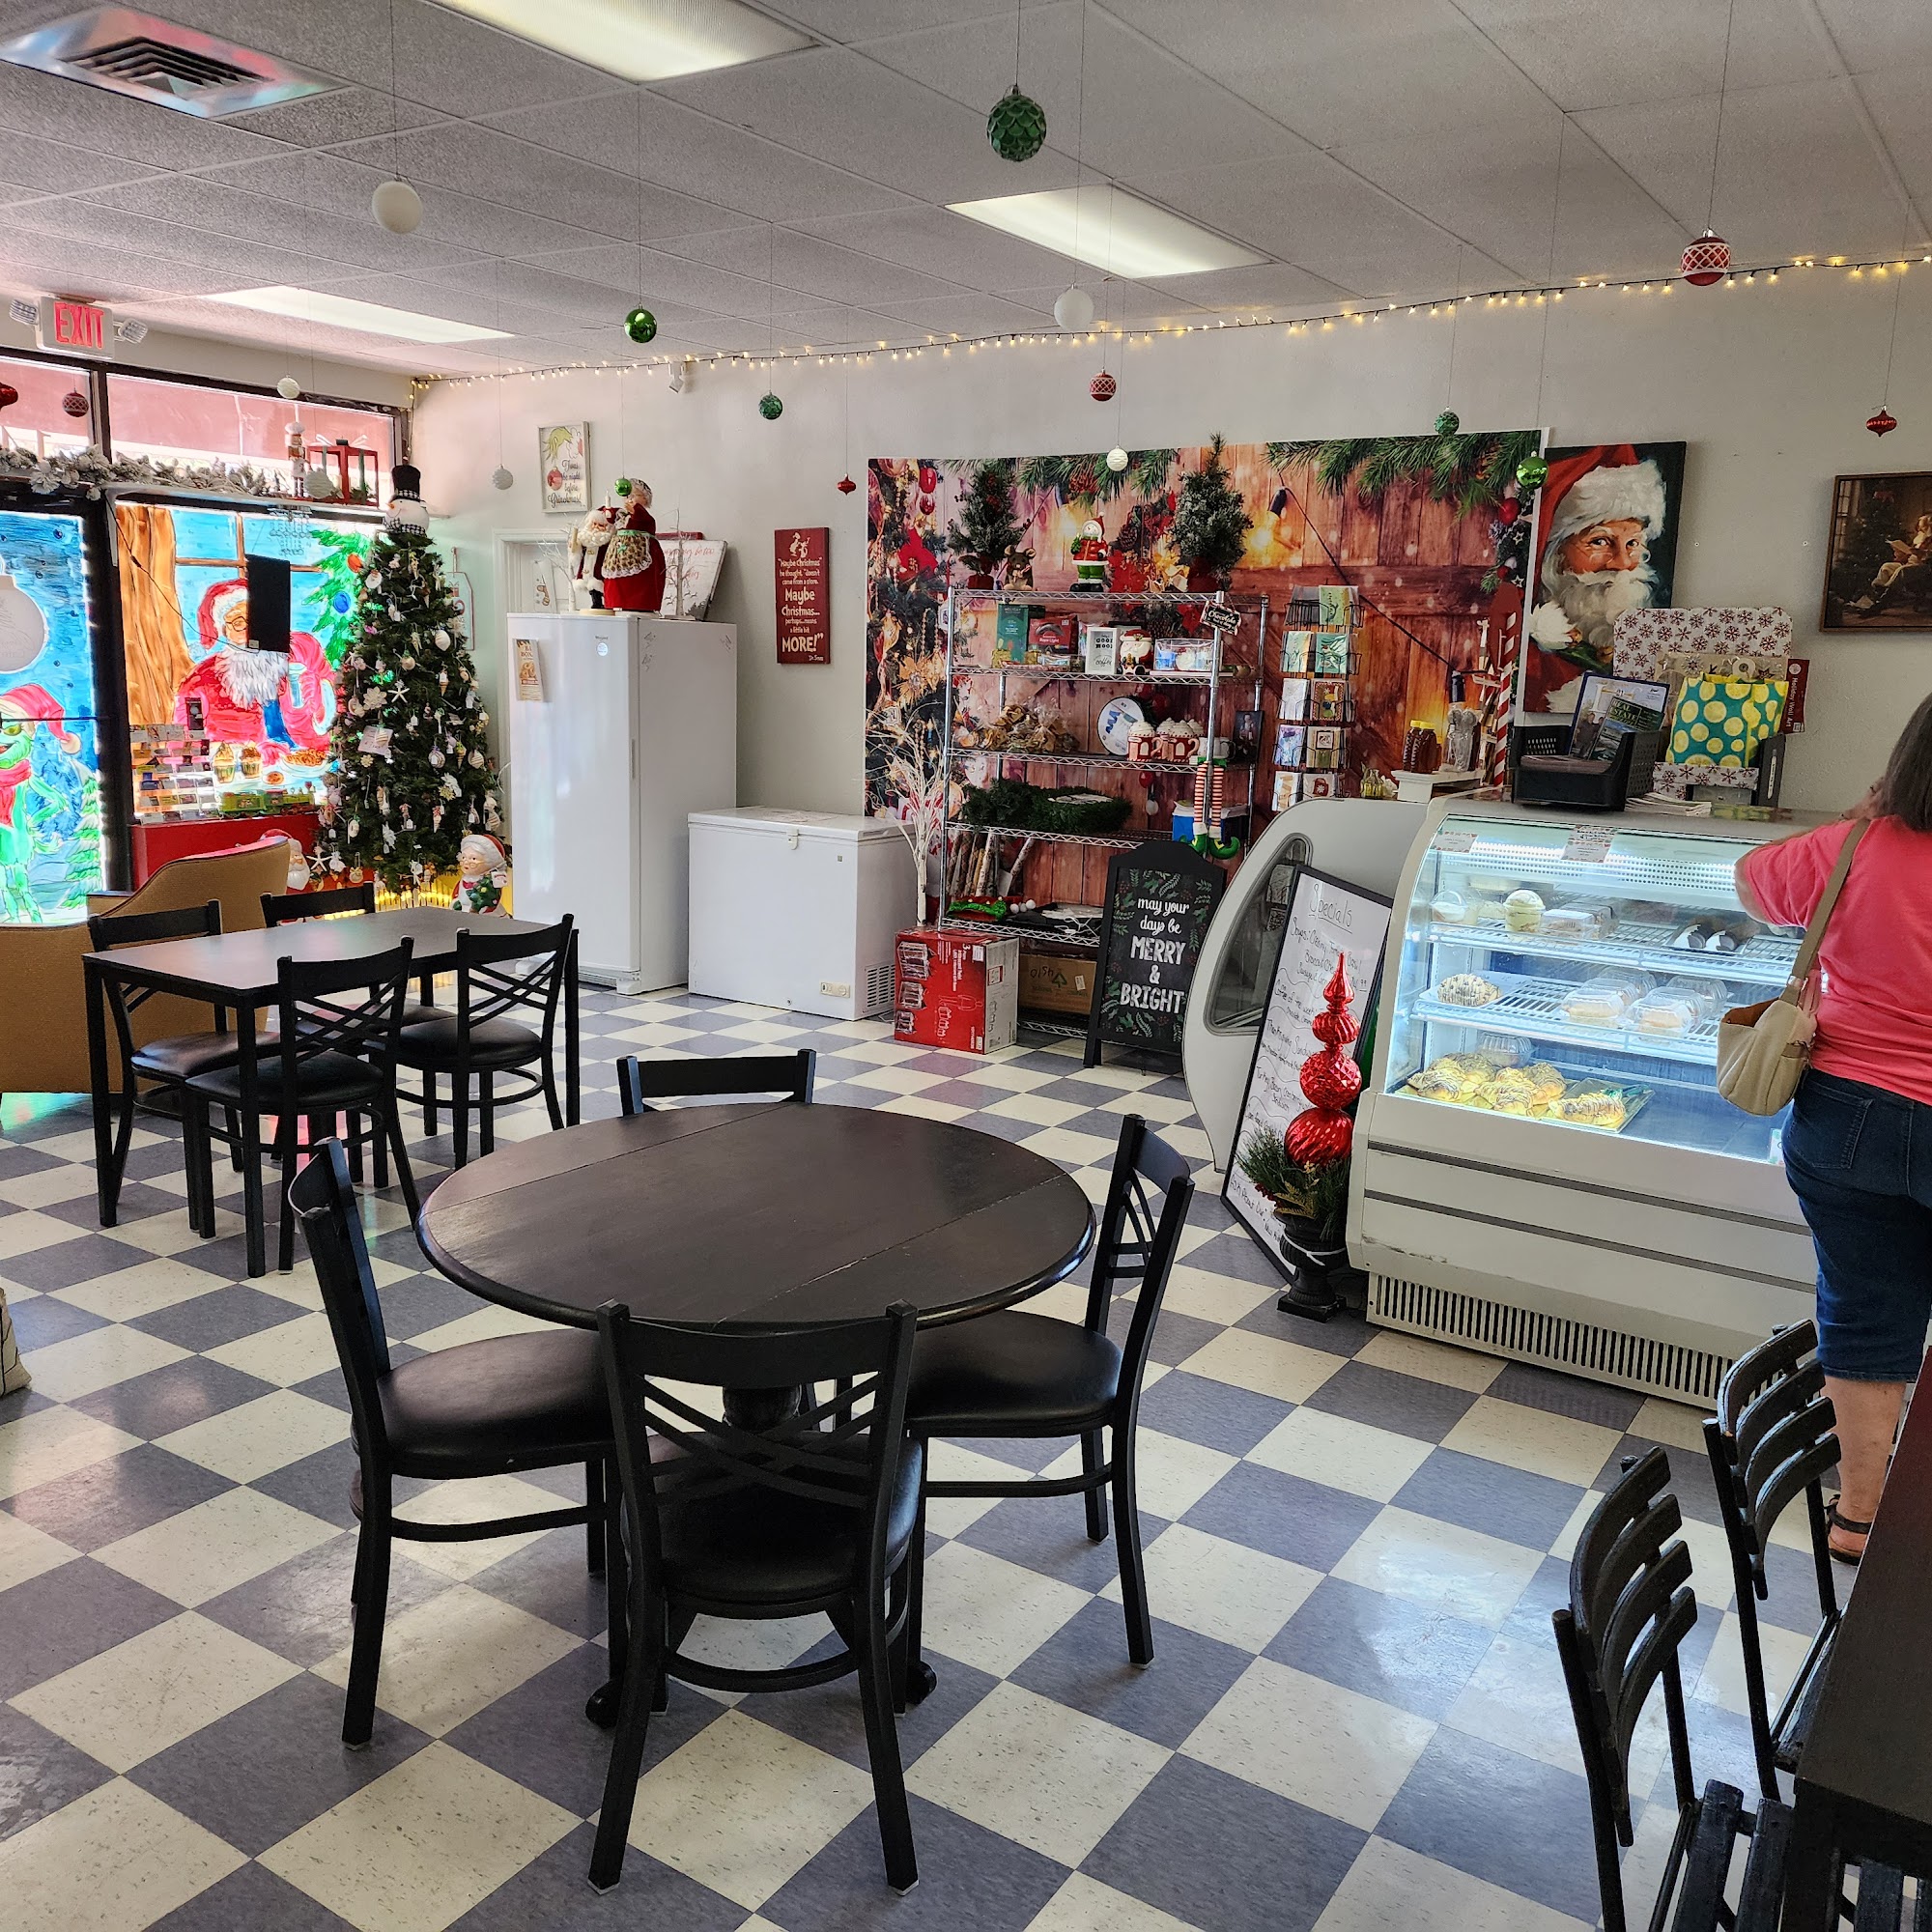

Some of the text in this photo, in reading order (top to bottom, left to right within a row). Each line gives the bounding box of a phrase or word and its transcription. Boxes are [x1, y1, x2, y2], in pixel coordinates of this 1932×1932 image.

[54, 302, 104, 349] EXIT
[785, 585, 815, 606] Maybe
[1789, 677, 1798, 701] Holiday
[1138, 898, 1189, 917] may your
[1309, 883, 1352, 927] Specials
[1140, 915, 1181, 936] days be
[1130, 935, 1186, 965] MERRY
[1149, 964, 1160, 984] &
[1121, 981, 1184, 1014] BRIGHT
